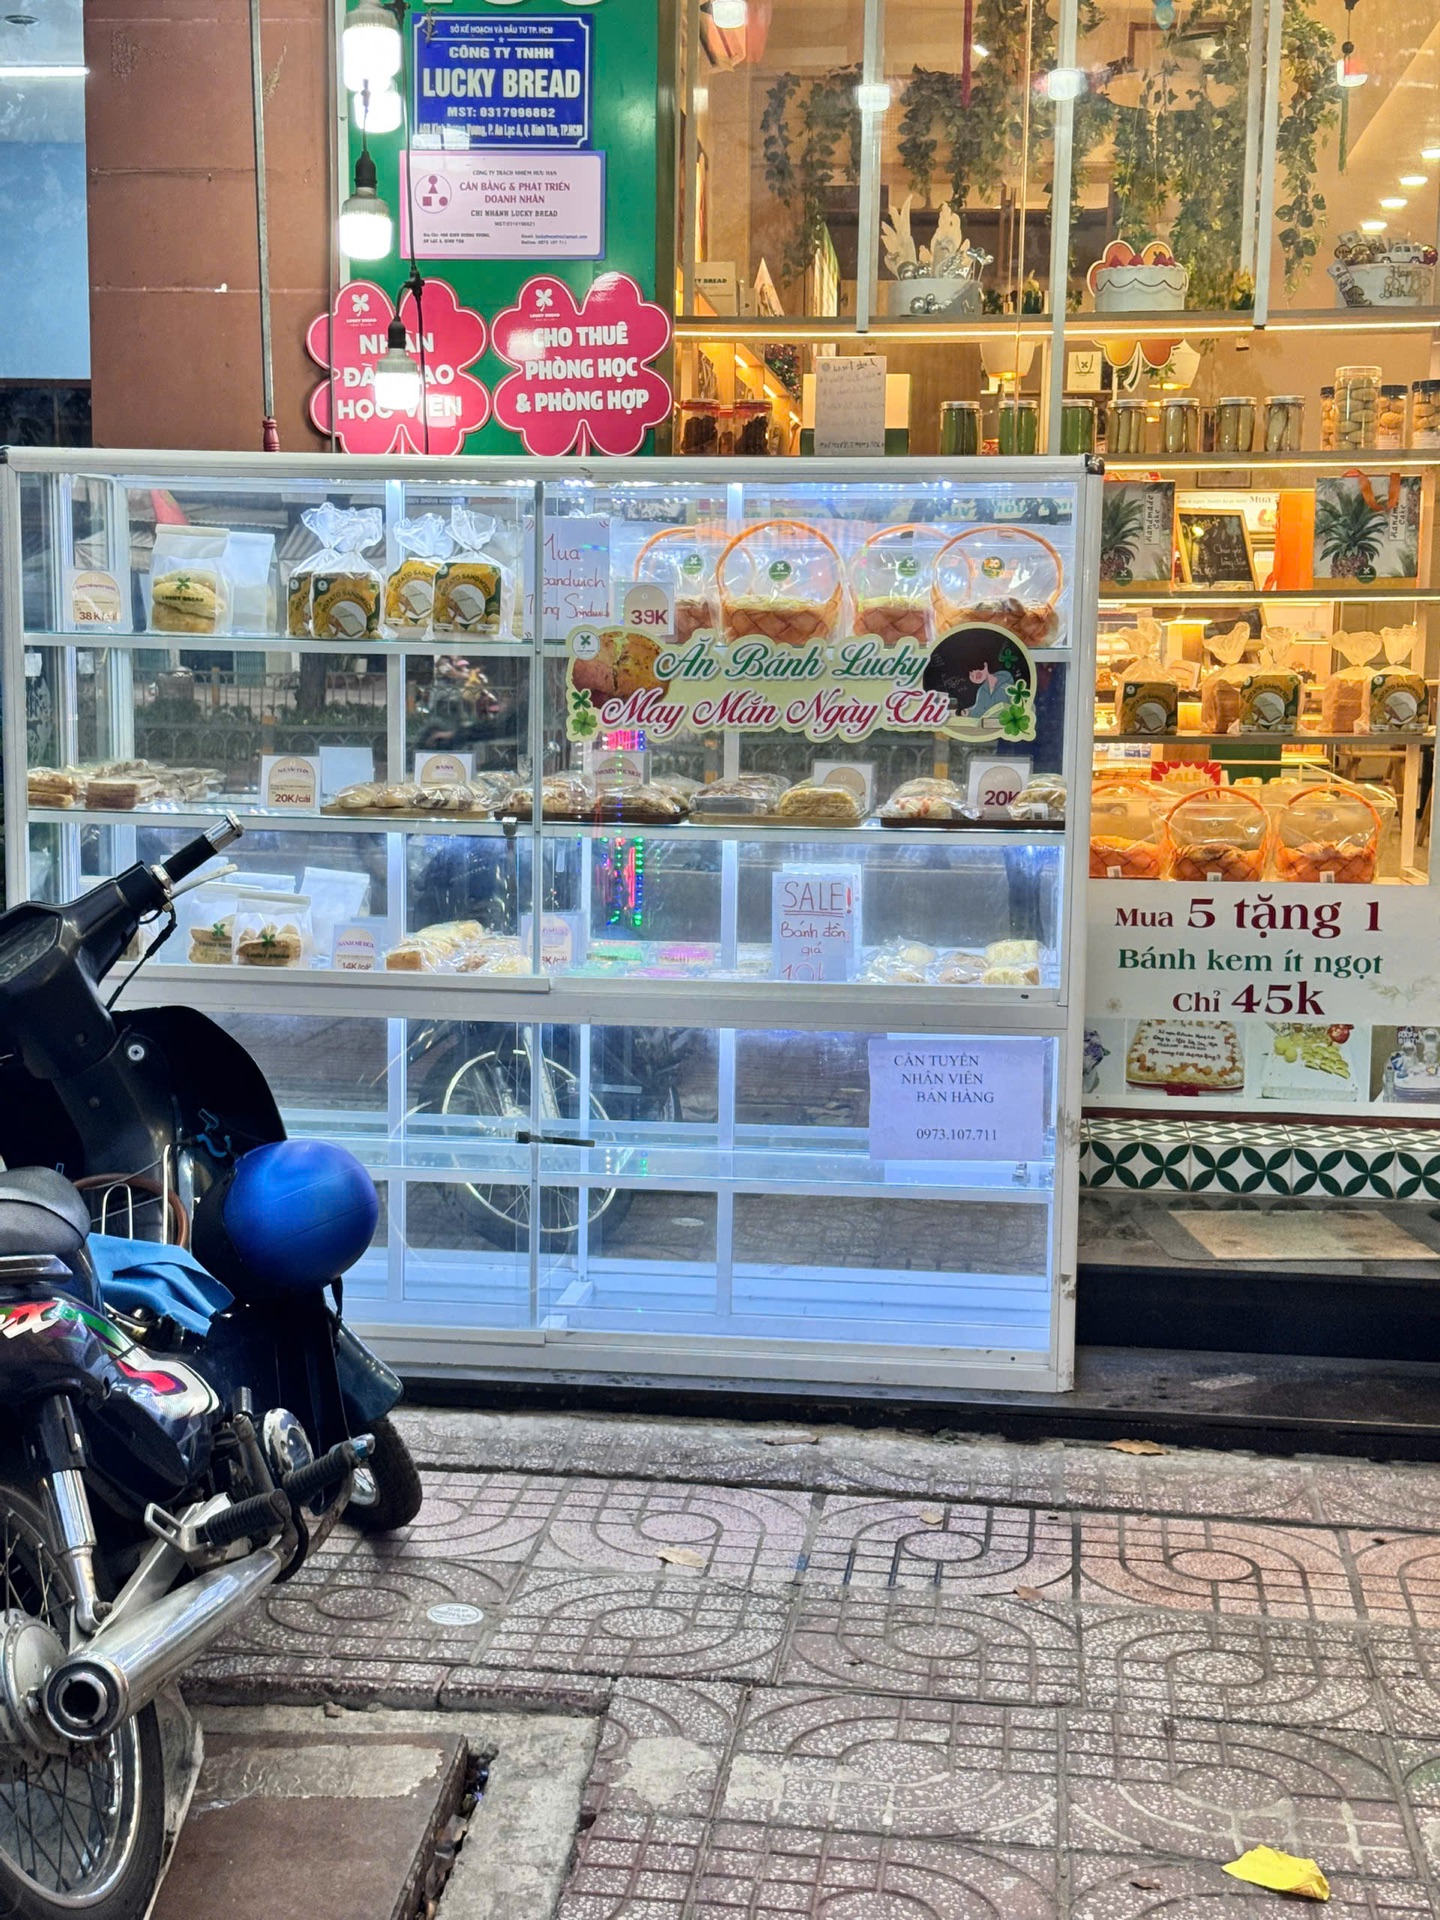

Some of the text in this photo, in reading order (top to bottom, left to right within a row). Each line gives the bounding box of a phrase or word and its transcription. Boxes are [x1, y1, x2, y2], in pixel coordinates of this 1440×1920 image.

[471, 26, 493, 35] HOẠCH
[494, 24, 503, 34] VÀ
[449, 44, 554, 59] CÔNG TY TNHH
[423, 68, 581, 98] LUCKY BREAD
[447, 107, 556, 118] MST: 0317996862
[509, 183, 515, 191] &
[484, 195, 517, 204] DOANH
[533, 321, 629, 348] CHO THUÊ
[343, 362, 380, 388] ĐÀ
[525, 356, 638, 383] PHÒNG HỌC
[516, 388, 649, 415] & PHÒNG HỢP
[656, 636, 930, 687] Ăn Bánh Lucky
[601, 689, 948, 734] May Mắn Ngày Thi
[275, 793, 311, 803] 20K/cái
[782, 881, 852, 914] SALE!
[1114, 893, 1383, 939] Mua 5 tặng 1
[781, 920, 818, 938] Bánh
[801, 941, 822, 960] giá
[1117, 946, 1384, 979] Bánh kem ít ngọt
[1172, 981, 1326, 1015] Chỉ 45k
[902, 1070, 984, 1085] NHÂN VIÊN
[917, 1087, 995, 1103] BÁN HÀNG
[916, 1128, 997, 1141] 0973.107.711
